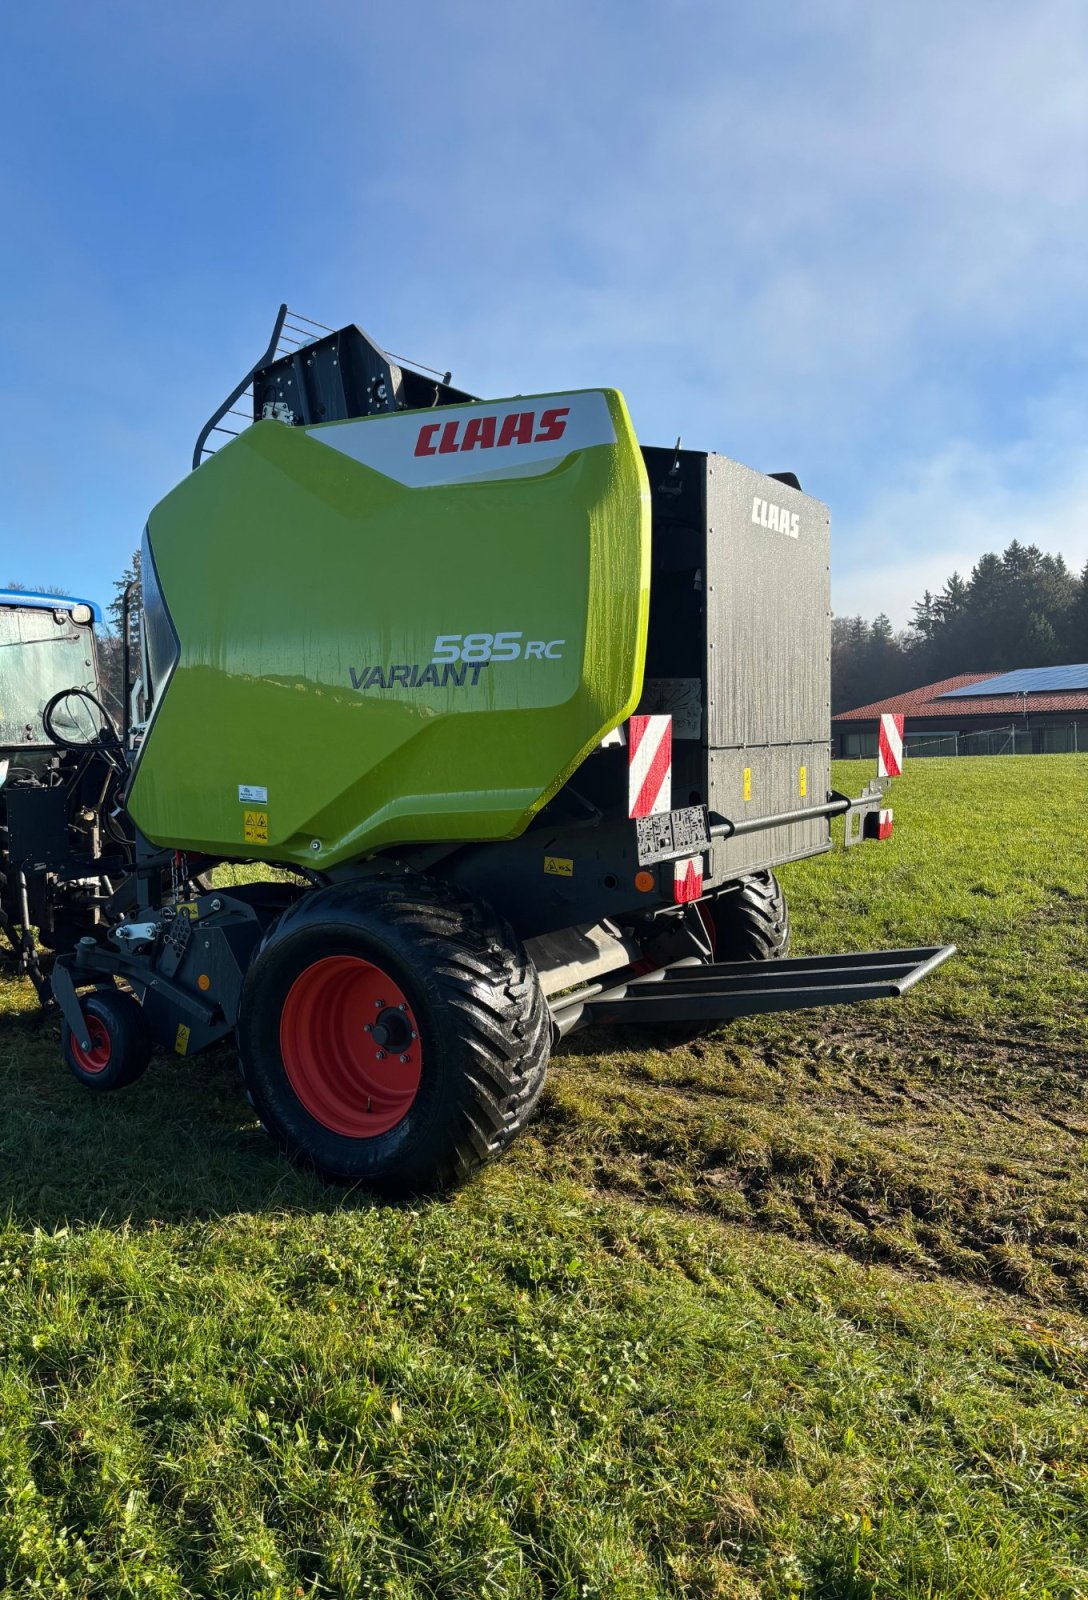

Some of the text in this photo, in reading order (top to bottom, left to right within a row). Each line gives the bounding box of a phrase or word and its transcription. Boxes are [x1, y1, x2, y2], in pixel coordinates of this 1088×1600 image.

[414, 408, 570, 457] CLAAS
[752, 497, 800, 539] CLAAS
[432, 632, 565, 664] 585 RC
[349, 662, 489, 689] VARIANT
